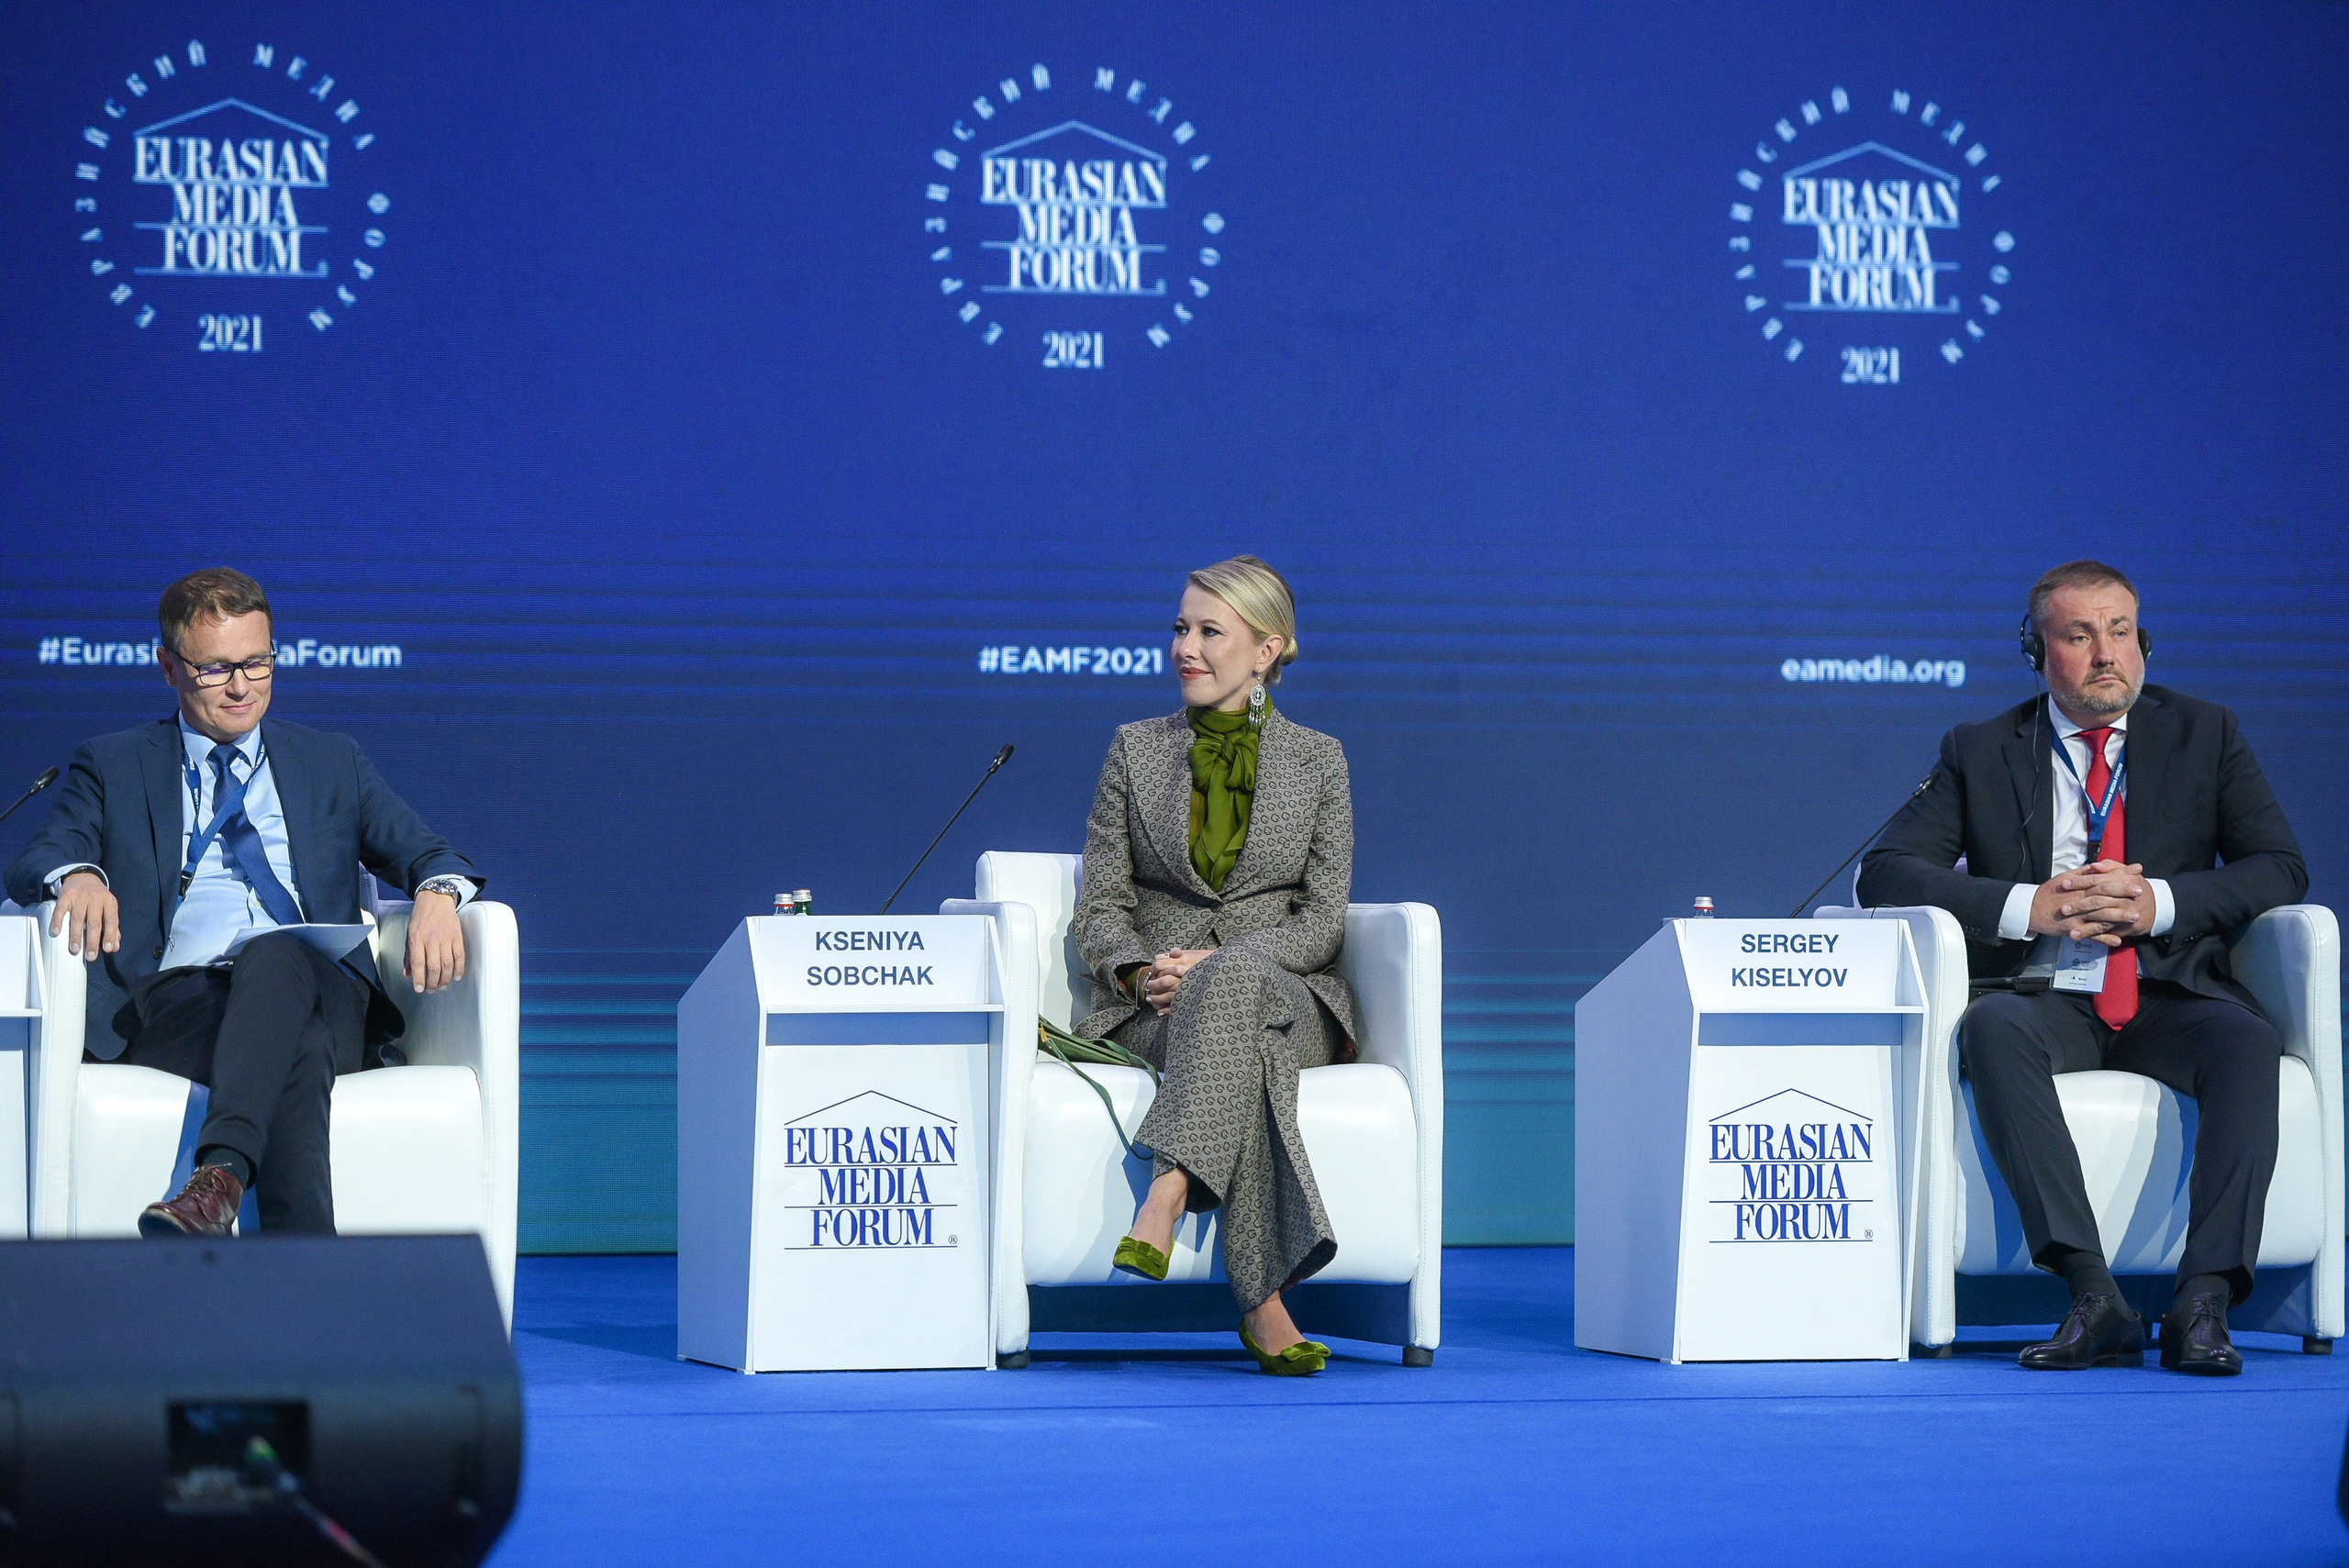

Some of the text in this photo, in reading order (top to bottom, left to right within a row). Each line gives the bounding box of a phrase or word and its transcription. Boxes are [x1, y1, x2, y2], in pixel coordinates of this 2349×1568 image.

[134, 137, 328, 183] EURASIAN
[982, 158, 1167, 204] EURASIAN
[171, 185, 299, 226] MEDIA
[1783, 179, 1960, 226] EURASIAN
[1018, 204, 1139, 244] MEDIA
[1818, 222, 1932, 264] MEDIA
[163, 228, 302, 272] FORUM
[1009, 247, 1141, 291] FORUM
[1809, 266, 1936, 309] FORUM
[198, 314, 263, 352] 2021
[1042, 330, 1104, 369] 2021
[1841, 347, 1899, 384] 2021
[979, 646, 1163, 675] #EAMF2021
[1781, 654, 1966, 688] eamedia.org
[2100, 794, 2113, 817] EURASIAN
[2114, 762, 2124, 780] FORUM
[815, 930, 925, 951] KSENIYA
[1741, 933, 1840, 954] SERGEY
[807, 965, 934, 986] SOBCHAK
[1731, 967, 1848, 987] KISELYOV
[784, 1126, 958, 1164] EURASIAN
[1709, 1123, 1874, 1161] EURASIAN
[818, 1166, 932, 1206] MEDIA
[1740, 1162, 1849, 1200] MEDIA
[809, 1207, 935, 1247] FORUM
[1733, 1203, 1852, 1240] FORUM
